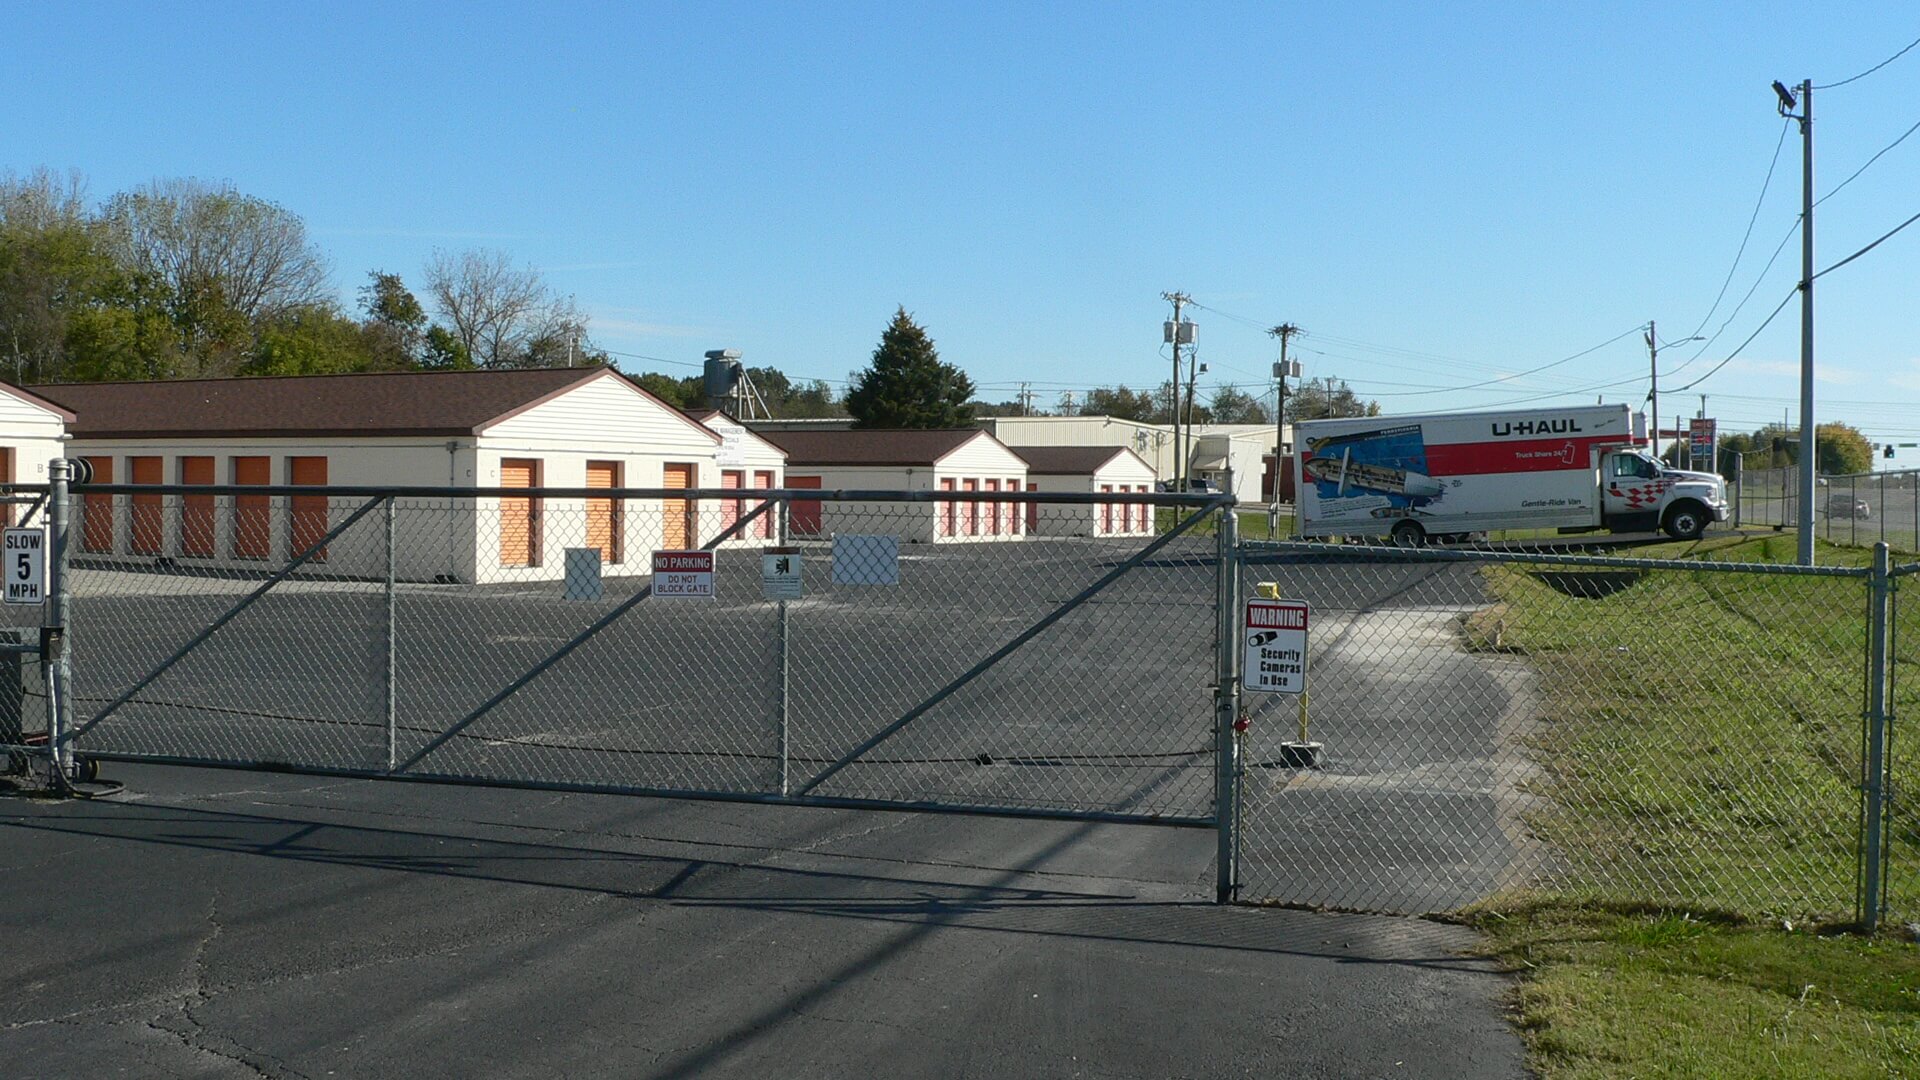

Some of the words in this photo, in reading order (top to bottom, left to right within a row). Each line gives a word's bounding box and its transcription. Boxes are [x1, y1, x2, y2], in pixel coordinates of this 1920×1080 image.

[1492, 419, 1582, 436] U-HAUL
[1521, 498, 1566, 507] Gentle-Ride
[1567, 498, 1582, 506] Van
[6, 535, 41, 549] SLOW
[17, 553, 31, 580] 5
[655, 557, 668, 569] NO
[670, 556, 710, 569] PARKING
[668, 575, 679, 584] DO
[681, 575, 697, 583] NOT
[9, 583, 38, 598] MPH
[657, 584, 684, 593] BLOCK
[687, 584, 709, 593] GATE
[1250, 607, 1304, 627] WARNING
[1261, 647, 1301, 662] Security
[1260, 661, 1301, 674] Cameras
[1259, 674, 1268, 685] In
[1271, 675, 1288, 687] Use
